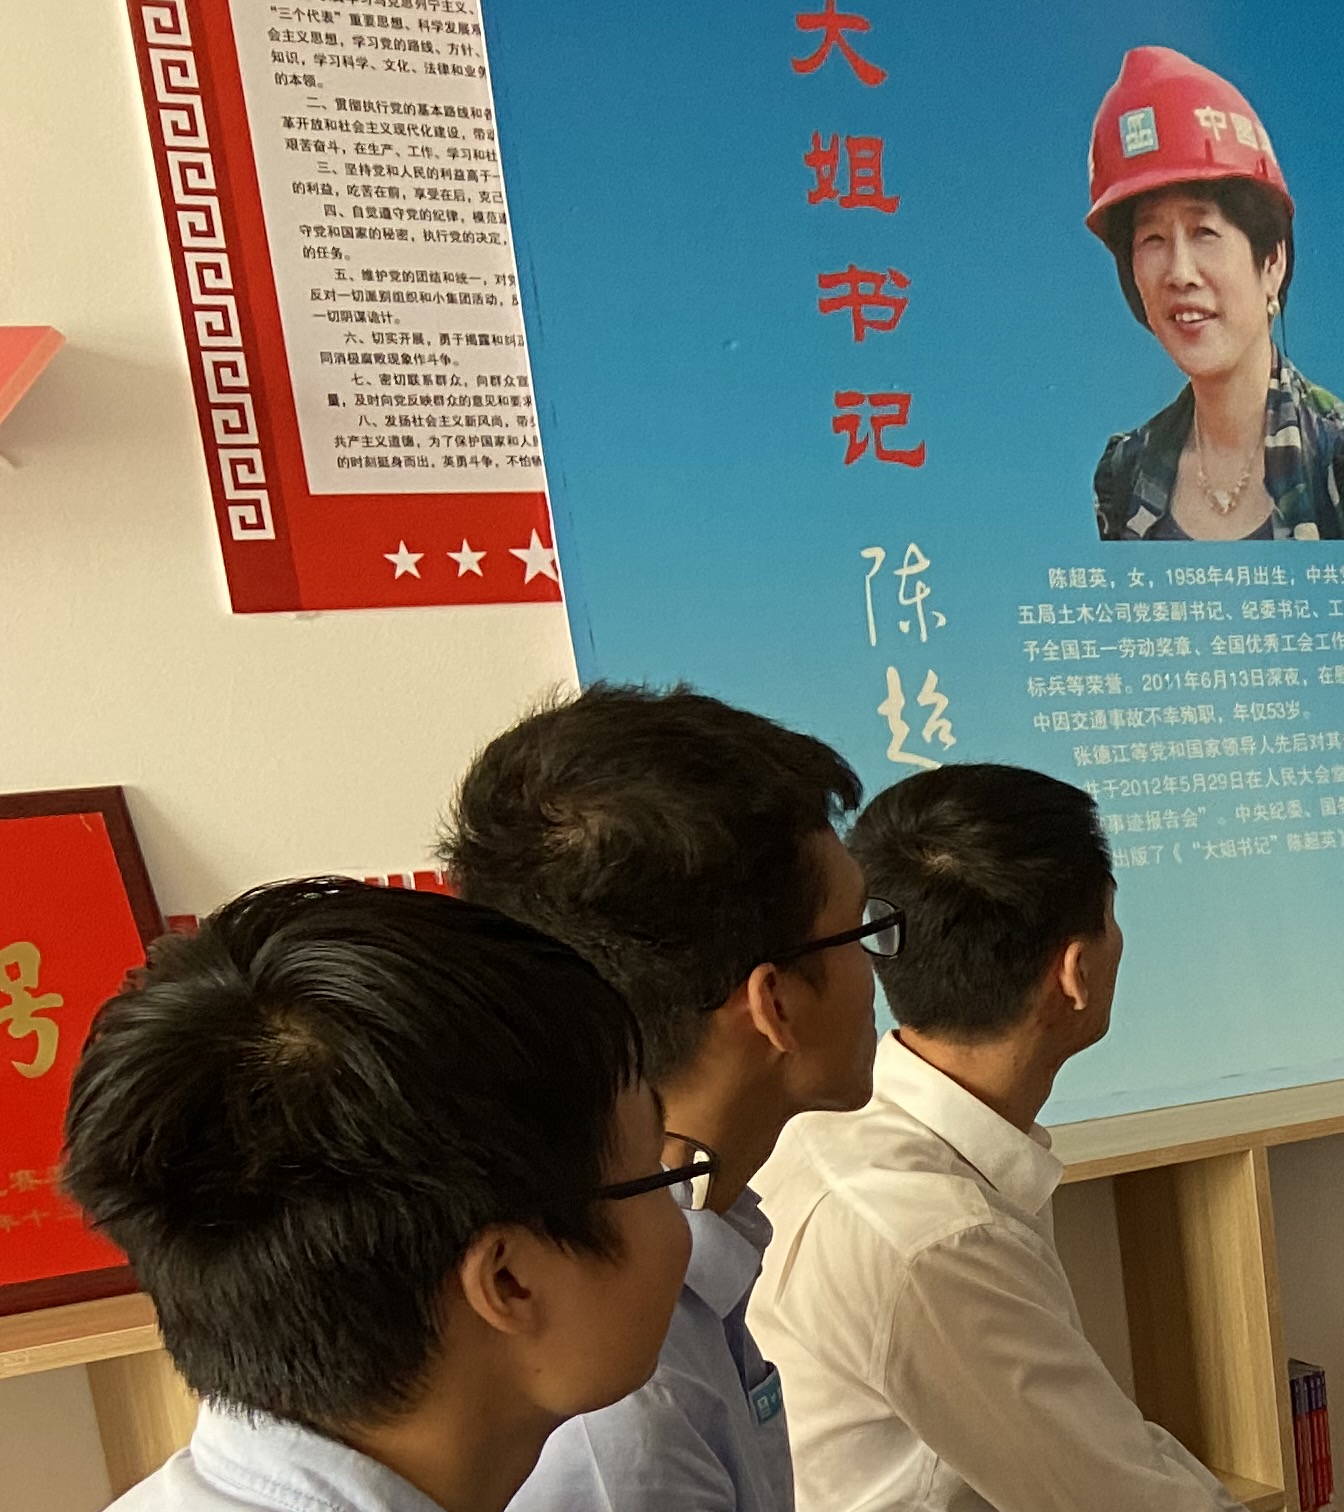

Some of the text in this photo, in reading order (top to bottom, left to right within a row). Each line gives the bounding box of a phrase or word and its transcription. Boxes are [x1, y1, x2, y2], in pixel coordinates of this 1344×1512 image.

[274, 72, 324, 89] 的本领。
[791, 0, 926, 468] 大姐书记
[302, 245, 350, 261] 的任务。
